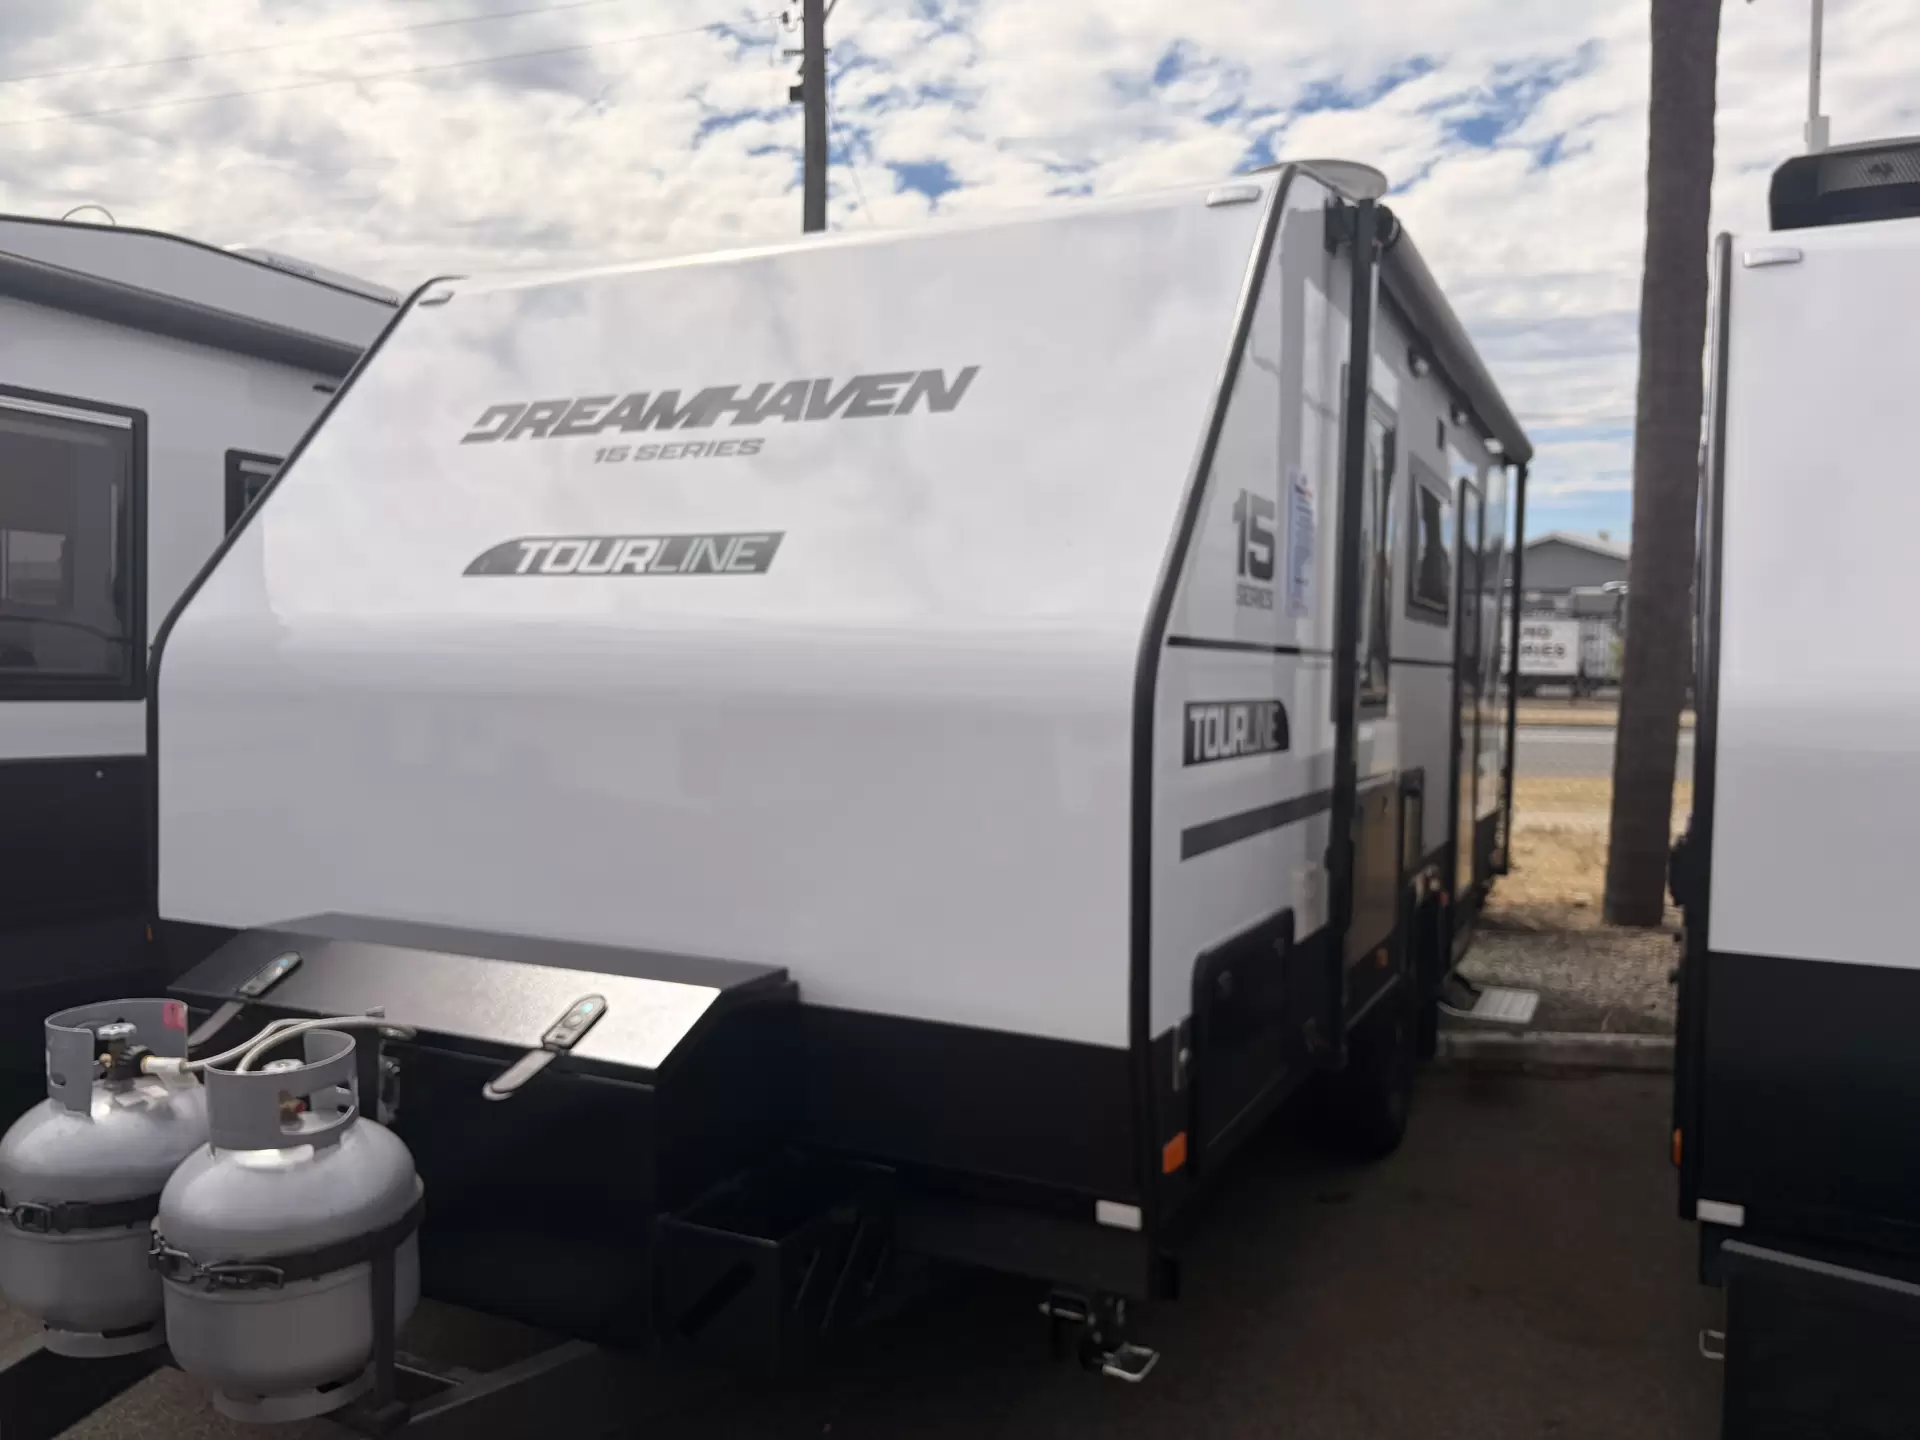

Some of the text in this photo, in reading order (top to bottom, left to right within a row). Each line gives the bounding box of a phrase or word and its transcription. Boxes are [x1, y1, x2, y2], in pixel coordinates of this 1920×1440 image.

[459, 365, 982, 444] DREAMHAVEN
[633, 437, 767, 462] SERIES
[515, 536, 770, 574] TOURLINE
[1232, 488, 1275, 581] 15
[1189, 704, 1281, 761] TOURLINE
